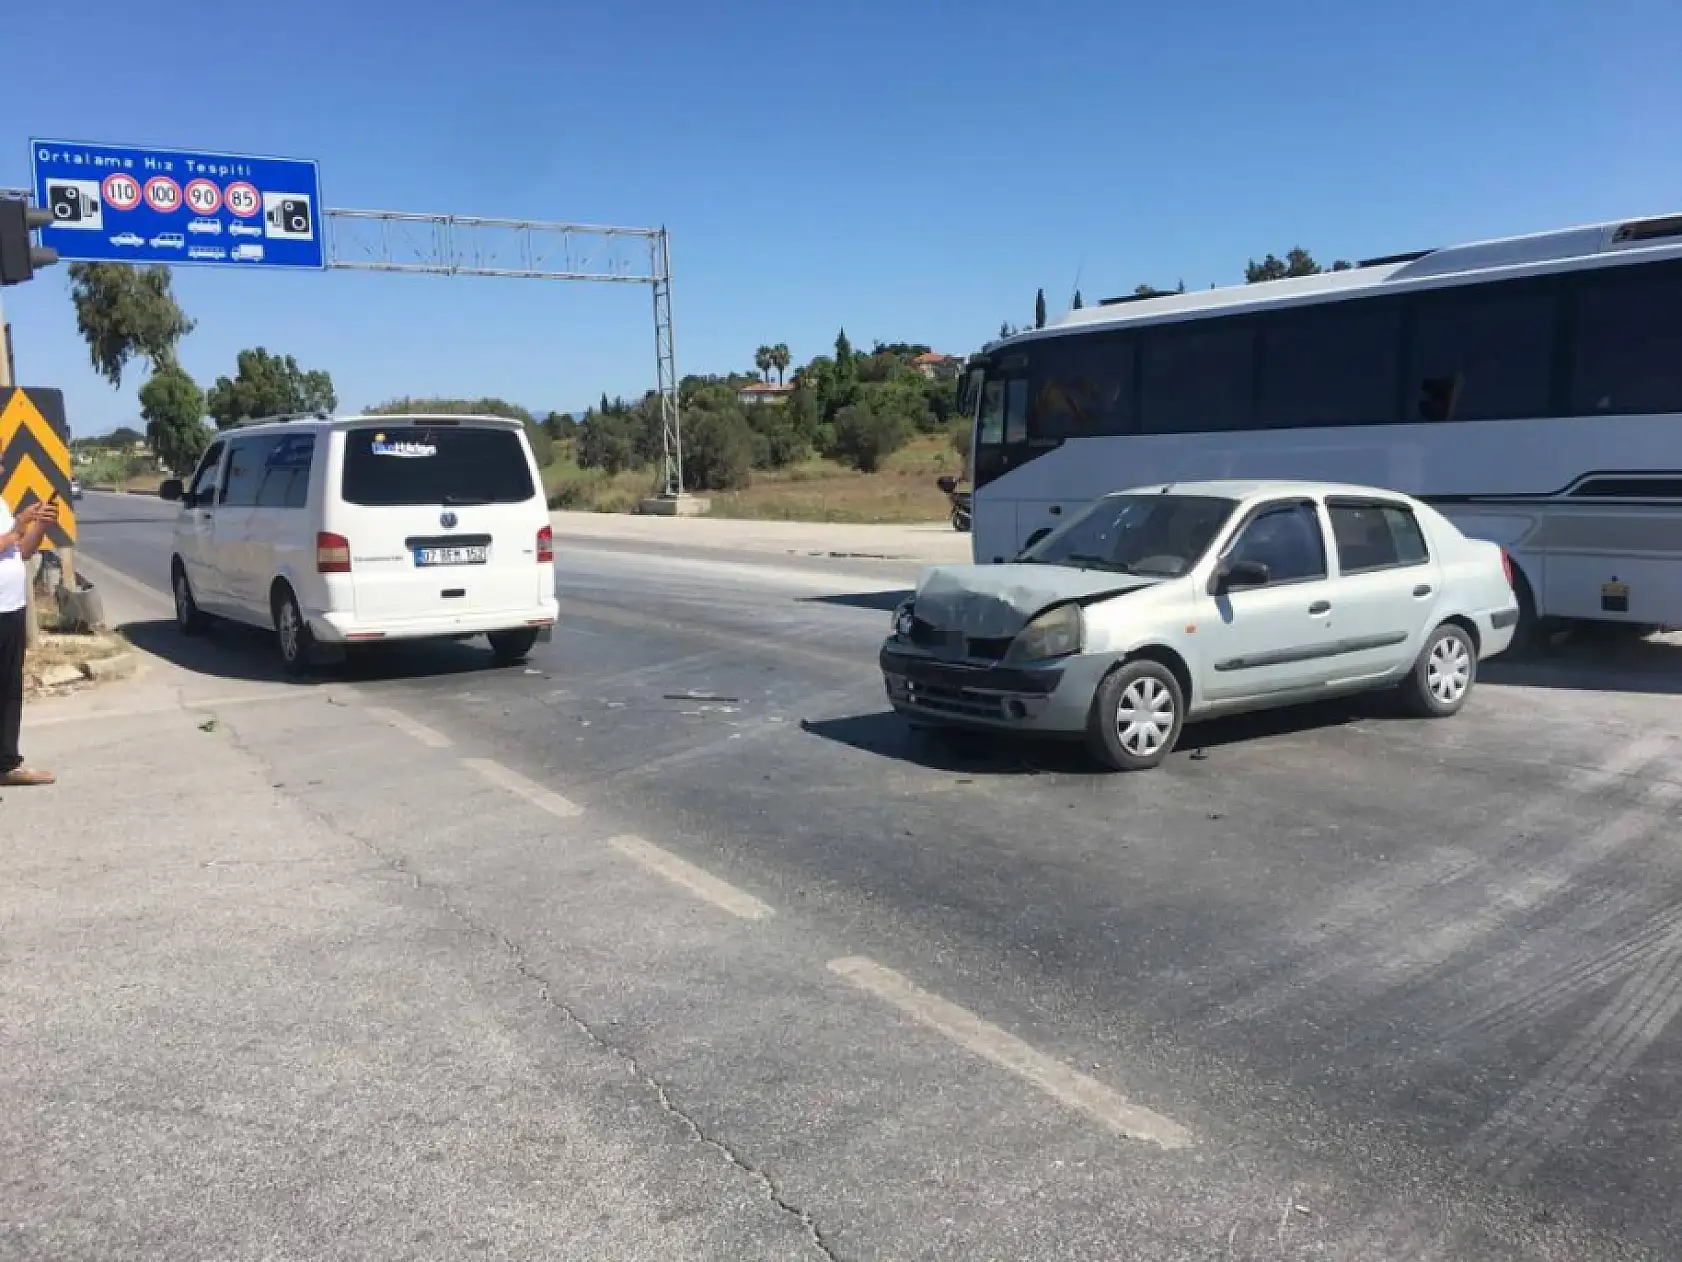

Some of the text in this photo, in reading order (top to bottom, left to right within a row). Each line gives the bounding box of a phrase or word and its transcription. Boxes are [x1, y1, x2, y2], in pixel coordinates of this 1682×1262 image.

[38, 148, 134, 168] Ortalama
[185, 160, 251, 177] Tespiti
[109, 183, 253, 206] 110 100 90 85
